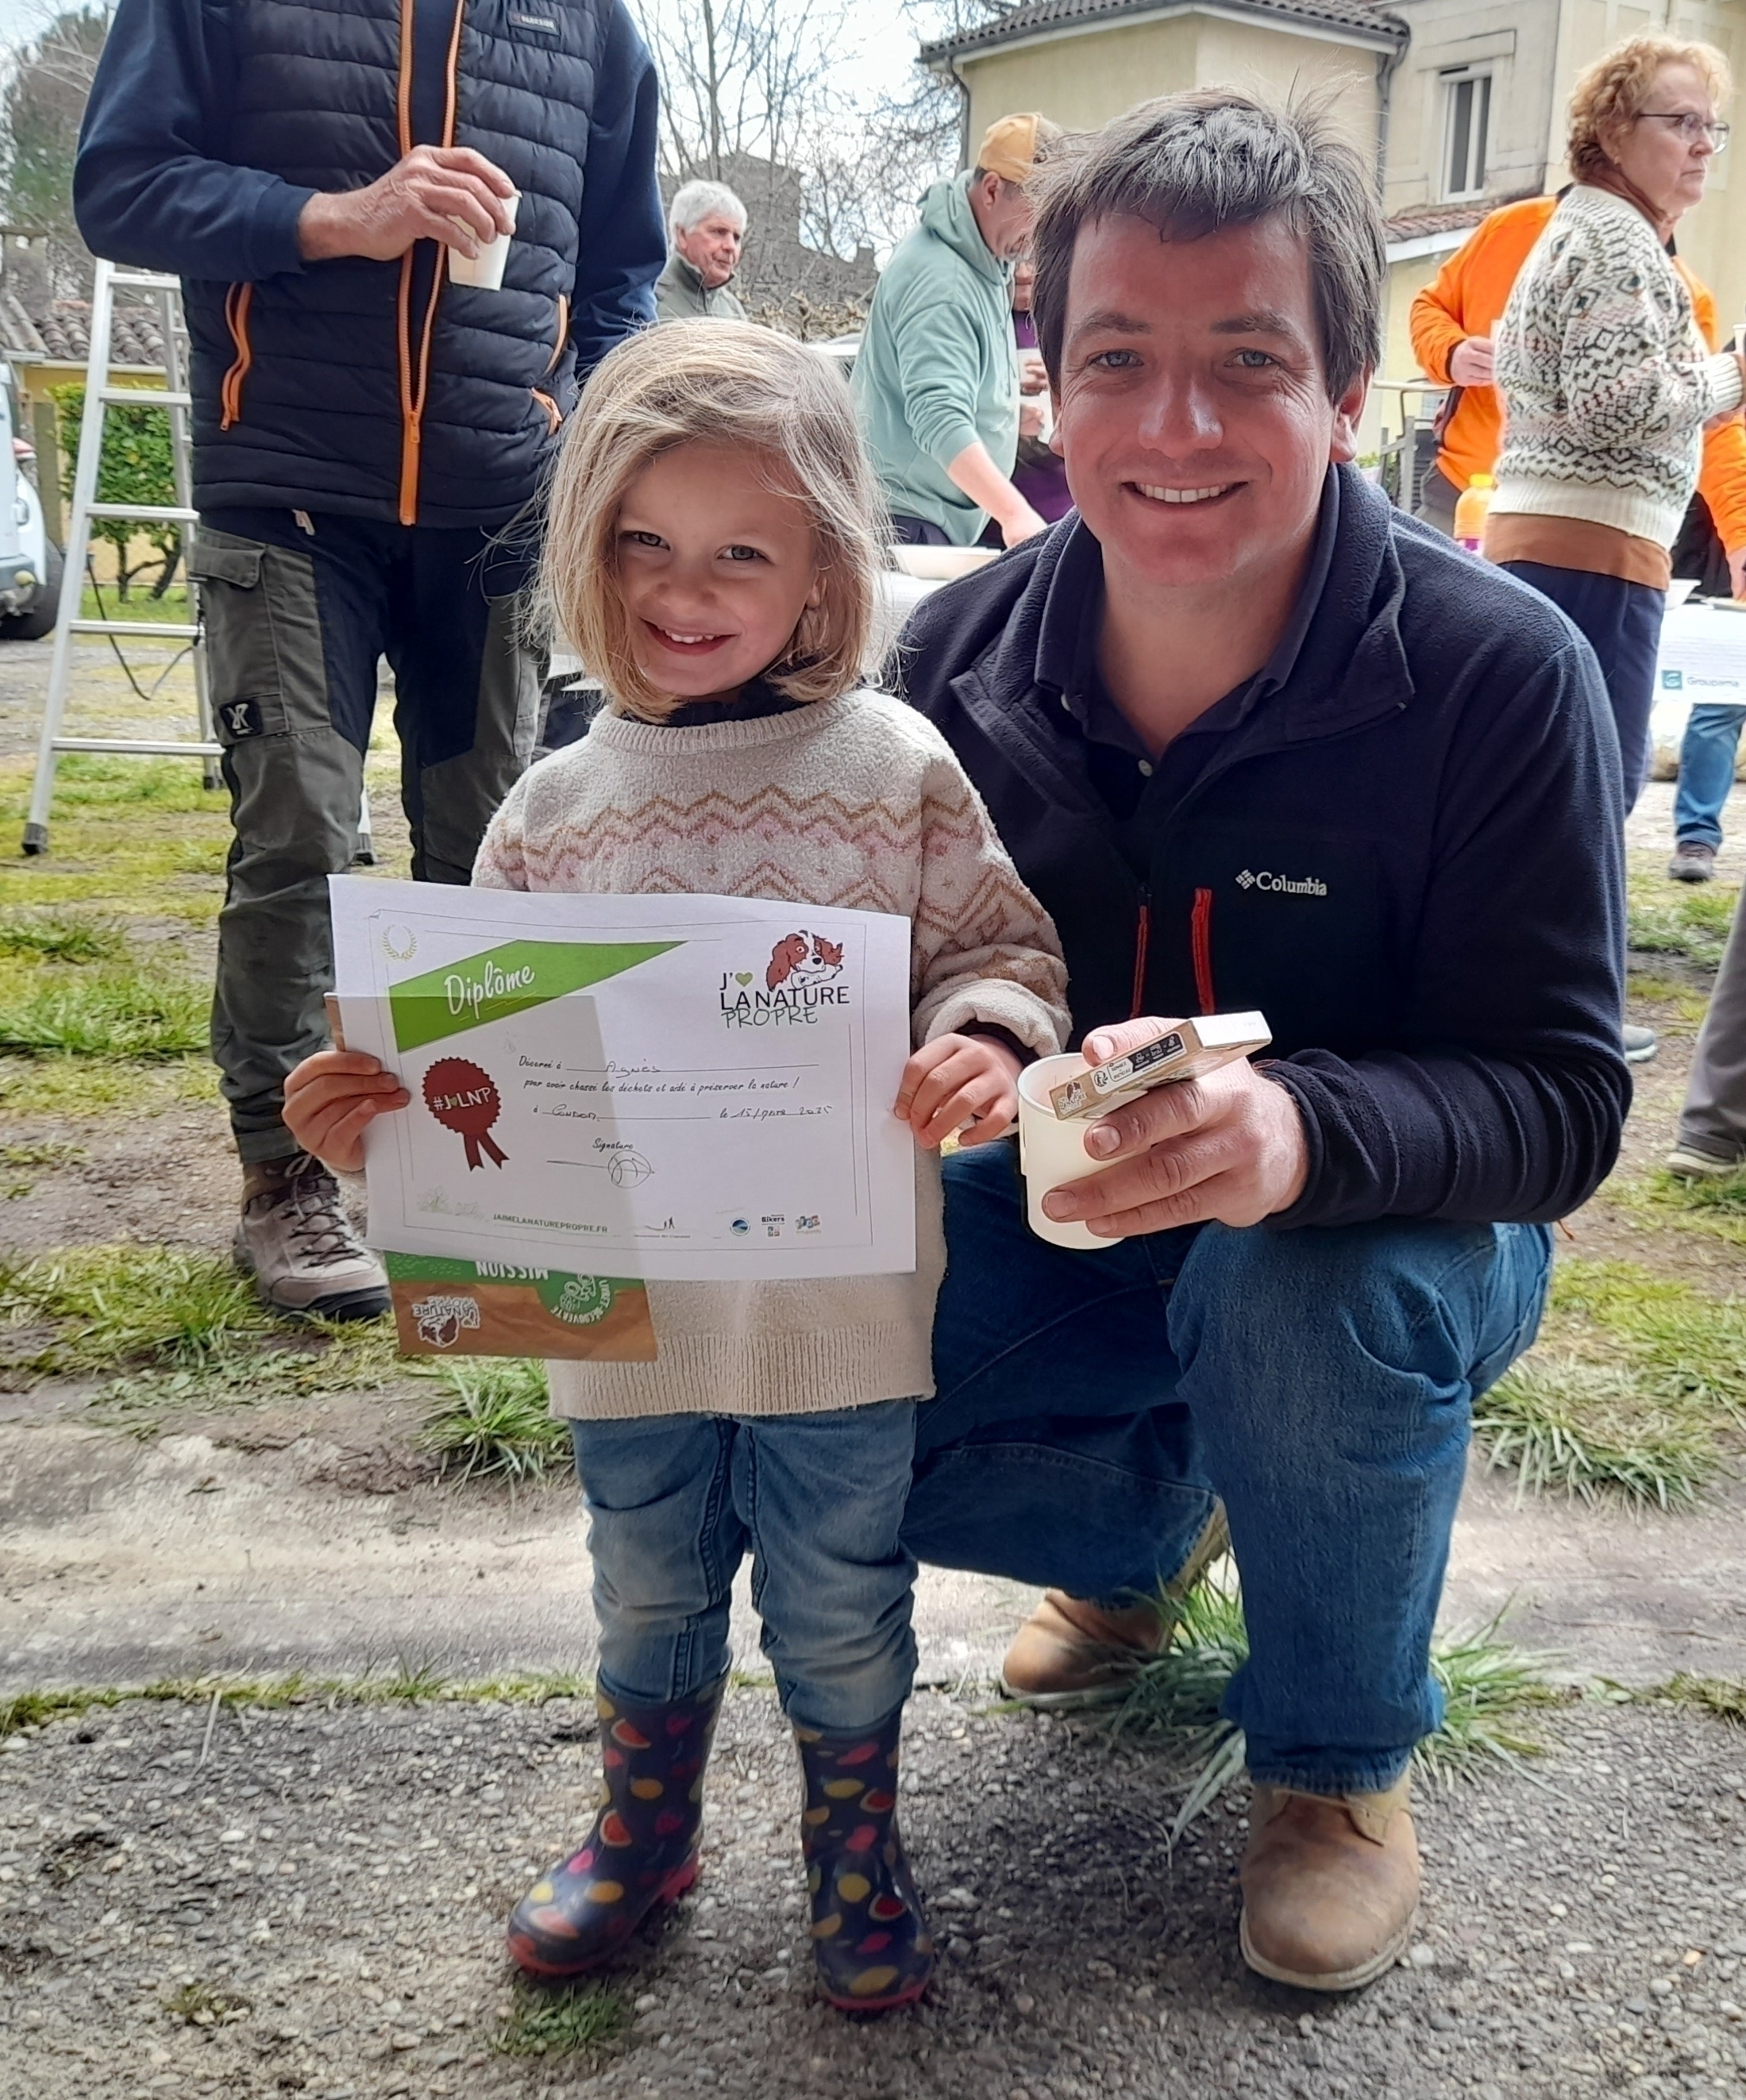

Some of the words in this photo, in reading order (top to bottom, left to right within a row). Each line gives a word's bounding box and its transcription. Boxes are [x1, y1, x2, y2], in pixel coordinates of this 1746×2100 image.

[1686, 677, 1740, 688] Groupama
[1255, 871, 1328, 896] Columbia
[443, 960, 536, 1020] Diplôme
[721, 1005, 819, 1029] PROPRE
[601, 1081, 615, 1092] les
[619, 1081, 653, 1092] déchets
[655, 1083, 667, 1092] et
[696, 1081, 744, 1096] préserver
[747, 1078, 757, 1089] la
[760, 1080, 788, 1089] nature
[719, 1107, 729, 1119] le
[492, 1213, 608, 1234] JAIMELANATUREPROPRE.FR
